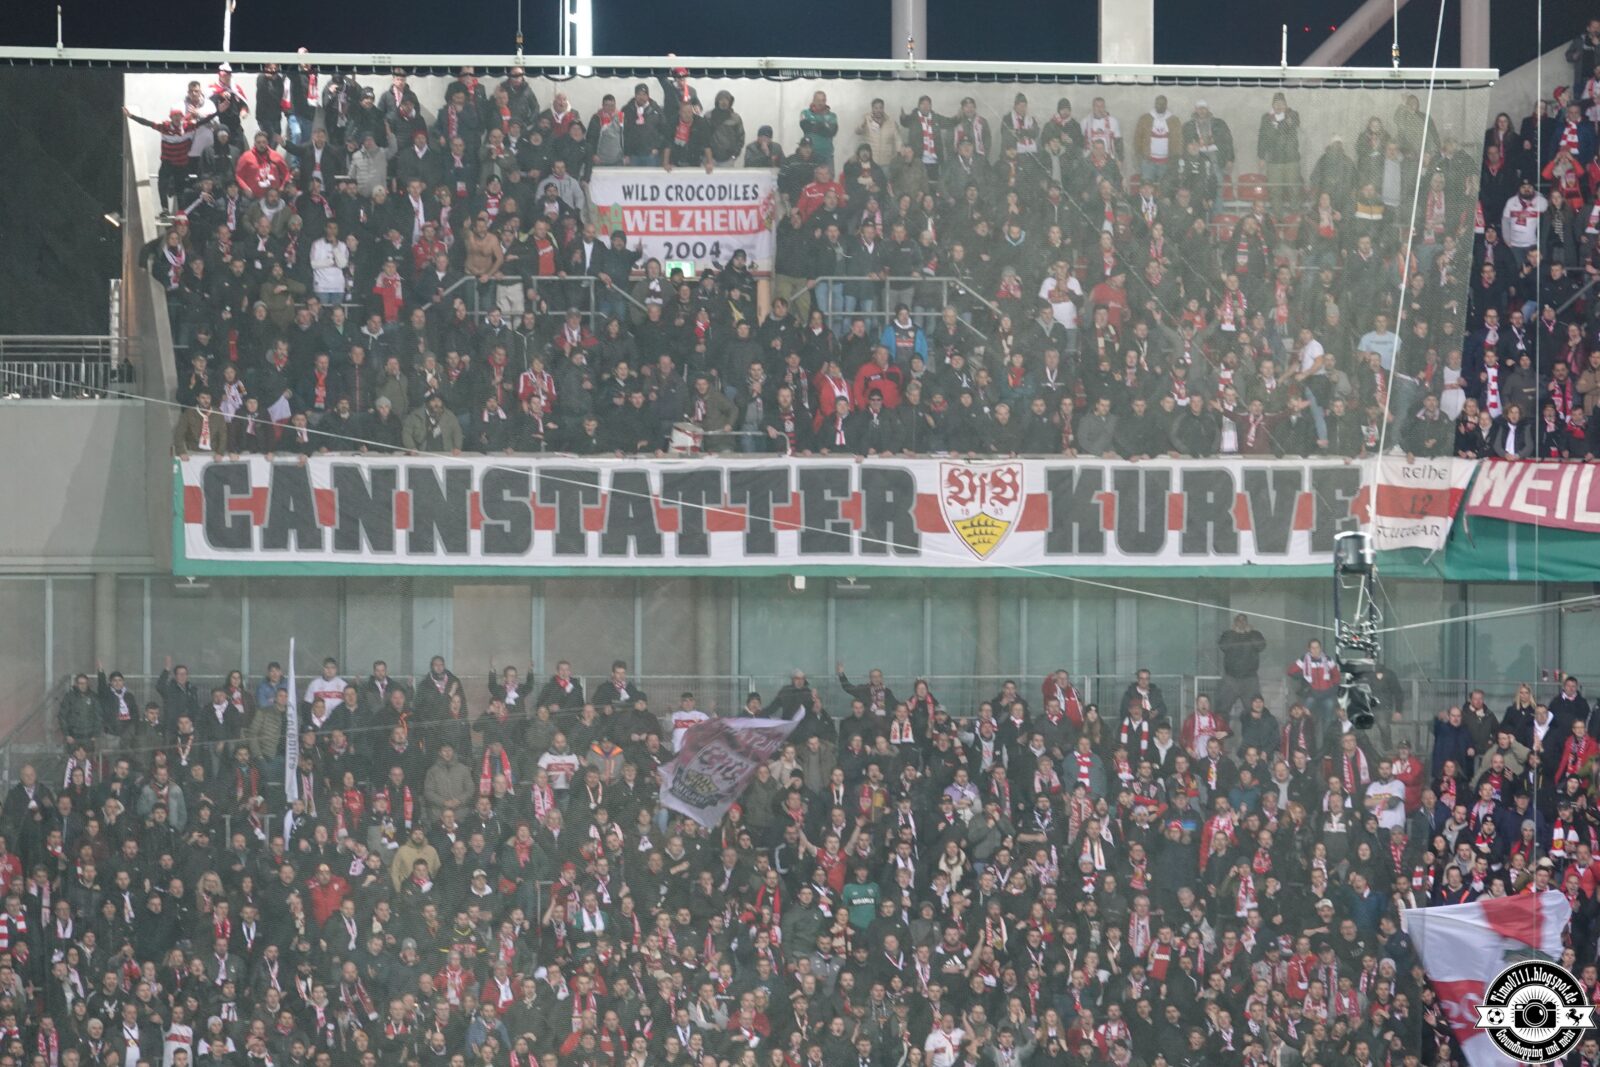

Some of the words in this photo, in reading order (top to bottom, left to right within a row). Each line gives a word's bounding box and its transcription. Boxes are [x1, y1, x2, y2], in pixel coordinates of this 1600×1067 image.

[622, 184, 660, 202] WILD
[664, 183, 760, 201] CROCODILES
[623, 208, 759, 233] WELZHEIM
[663, 240, 722, 260] 2004
[1466, 459, 1600, 523] WEIL
[200, 460, 923, 557] CANNSTATTER
[1043, 465, 1363, 557] KURVE
[1410, 494, 1434, 516] 12
